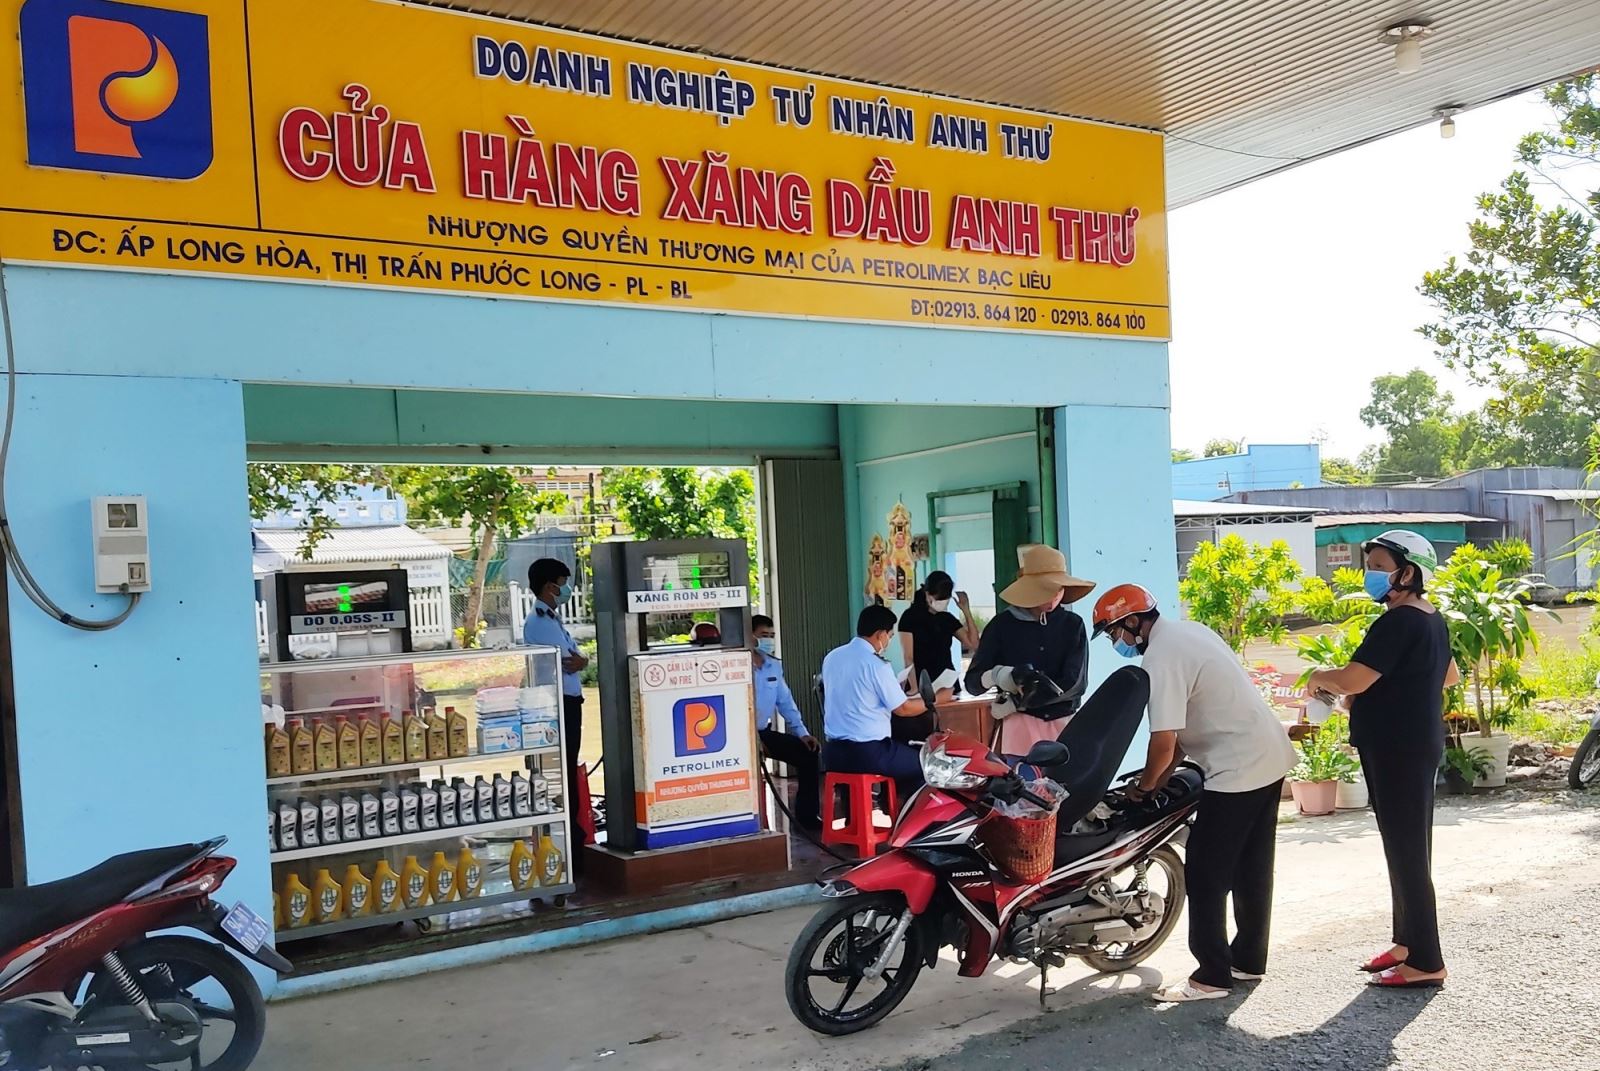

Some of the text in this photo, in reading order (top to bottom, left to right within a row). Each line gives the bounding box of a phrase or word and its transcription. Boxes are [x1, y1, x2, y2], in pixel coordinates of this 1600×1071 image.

[475, 36, 1053, 162] DOANH NGHIỆP TƯ NHÂN ANH THƯ
[278, 83, 1139, 267] CỬA HÀNG XĂNG DẦU ANH THƯ
[53, 229, 106, 254] ĐC:
[117, 225, 154, 257] ẤP
[167, 238, 245, 263] LONG
[256, 239, 321, 274] HÒA,
[332, 251, 367, 279] THỊ
[378, 252, 442, 280] TRẤN
[451, 259, 531, 287] PHƯỚC
[541, 269, 601, 292] LONG
[626, 276, 649, 297] PL
[671, 279, 693, 299] BL
[427, 214, 1051, 290] NHƯỢNG QUYỀN THƯƠNG MẠI CỦA PETROLIMEX BẠC LIÊU
[983, 304, 1010, 322] 864
[1014, 306, 1037, 323] 120
[1096, 312, 1121, 329] 864
[1126, 315, 1146, 330] 100
[674, 591, 699, 601] RON
[703, 590, 717, 599] 95
[304, 616, 324, 626] DO
[679, 674, 692, 685] FIRE
[662, 758, 741, 775] PETROLIMEX
[951, 870, 985, 878] HONDA
